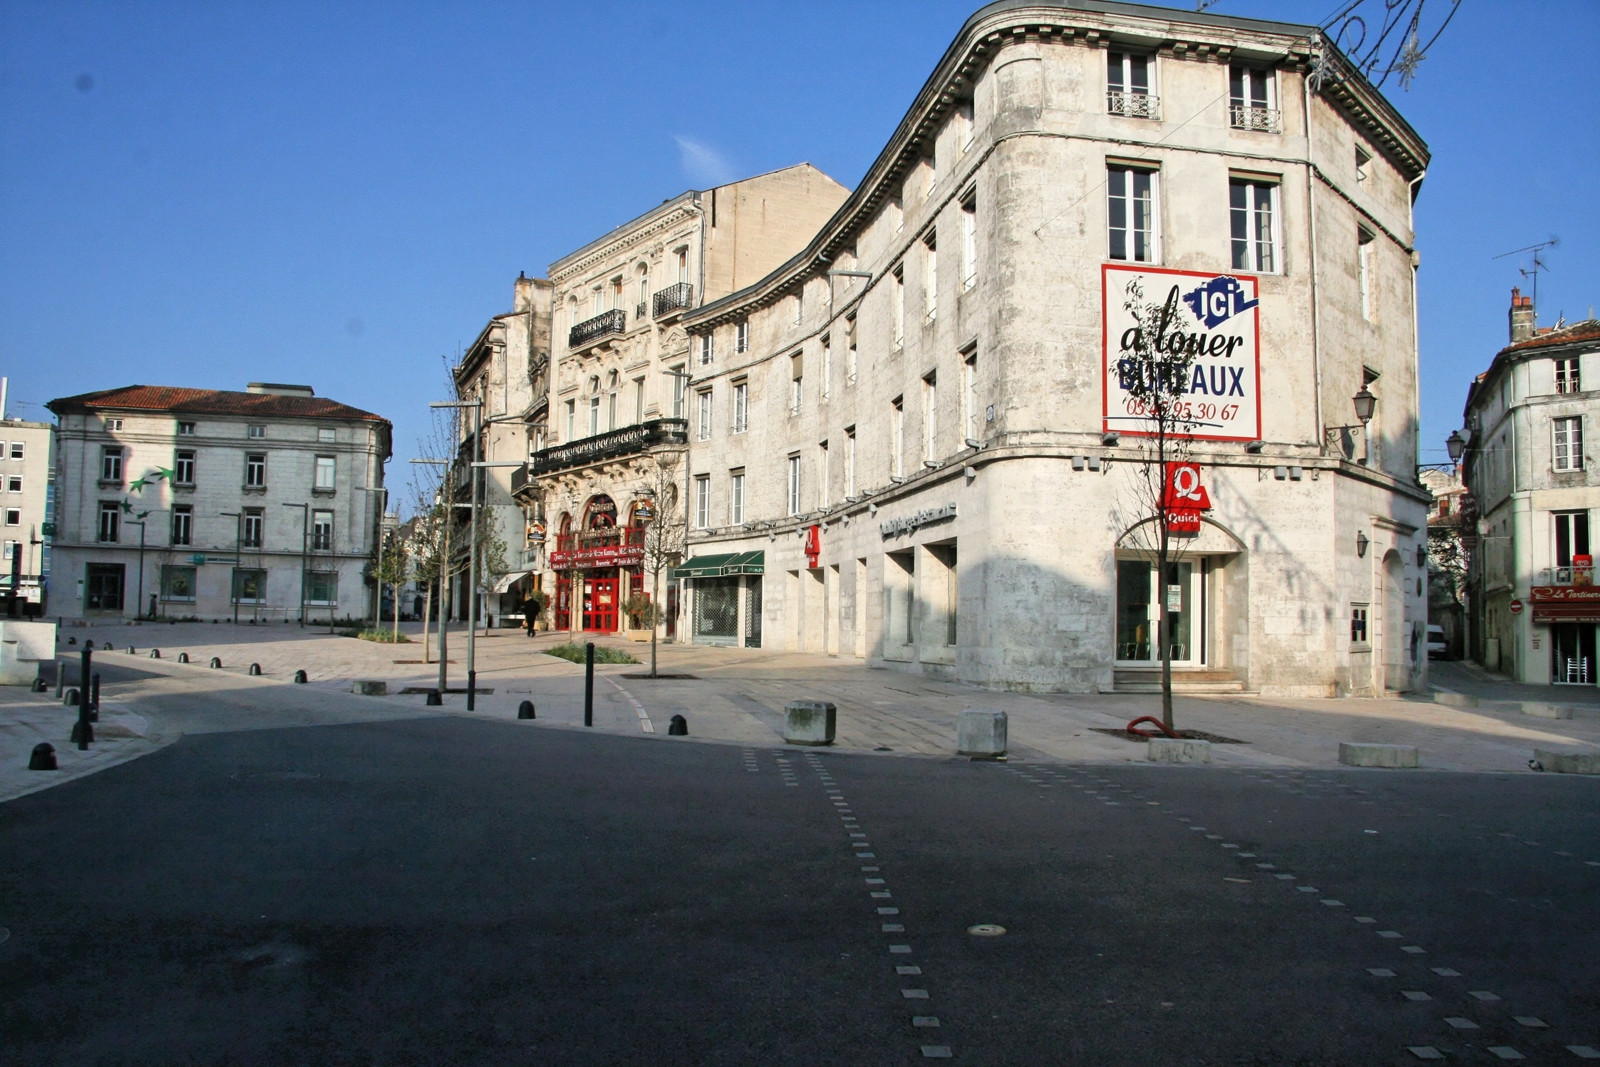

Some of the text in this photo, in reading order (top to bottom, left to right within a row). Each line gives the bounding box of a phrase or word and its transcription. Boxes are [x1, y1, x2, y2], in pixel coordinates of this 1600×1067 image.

[1154, 284, 1243, 358] louer
[1119, 358, 1245, 398] BUREAUX
[1126, 398, 1146, 415] 05
[1173, 401, 1192, 419] 95
[1197, 402, 1217, 420] 30
[1220, 403, 1240, 421] 67
[1174, 466, 1202, 501] Q
[1168, 512, 1199, 524] Quick
